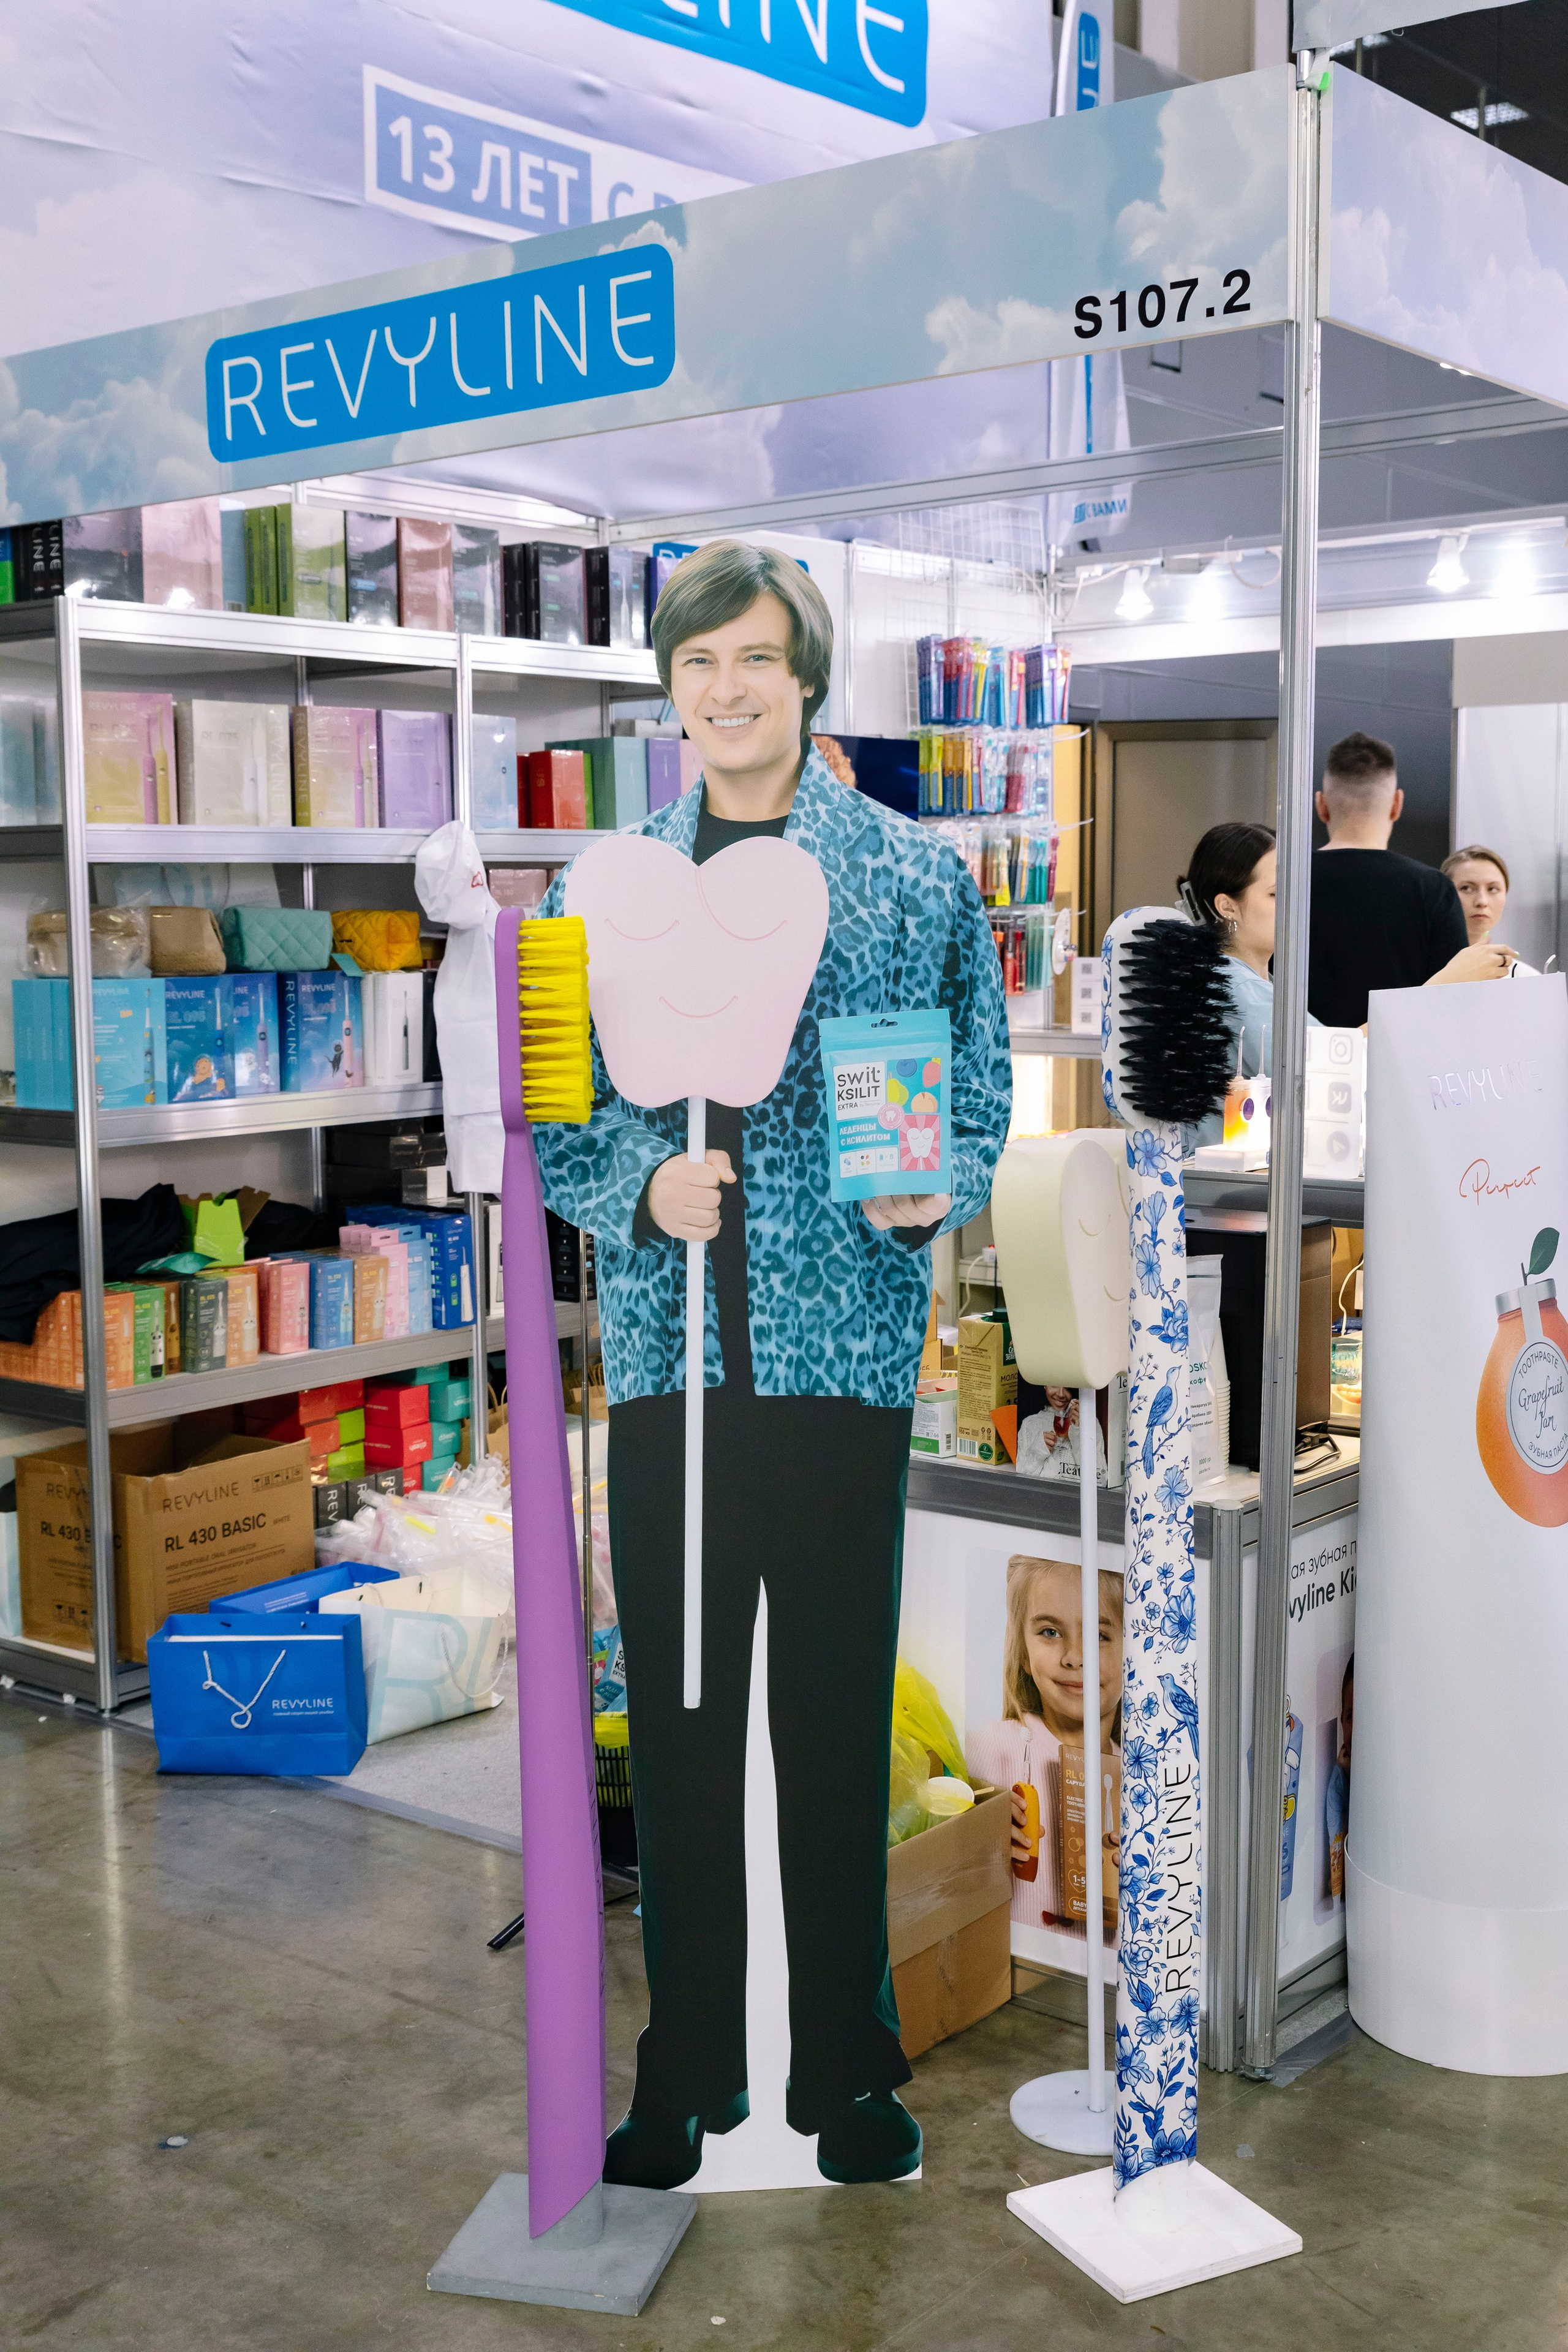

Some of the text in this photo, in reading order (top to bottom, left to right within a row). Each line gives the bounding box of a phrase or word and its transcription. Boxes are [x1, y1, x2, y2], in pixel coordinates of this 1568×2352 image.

[388, 115, 455, 192] 13
[472, 140, 579, 225] ЛЕТ
[1074, 269, 1251, 339] S107.2
[222, 270, 654, 441] REVYLINE
[165, 990, 205, 1000] REVYLINE
[301, 982, 336, 993] REVYLINE
[285, 981, 297, 1065] REVYLINE
[837, 1086, 880, 1102] KSILIT
[840, 1123, 876, 1135] ЛЕДЕНЦЫ
[846, 1133, 891, 1145] КСИЛИТОМ
[1518, 1351, 1559, 1378] TOOTHPASTE
[1189, 1377, 1207, 1385] кофе
[1518, 1375, 1564, 1421] Grapefruit
[1536, 1411, 1558, 1439] Jam
[1528, 1441, 1553, 1460] ЗУБНАЯ
[162, 1482, 239, 1513] REVYLINE
[40, 1521, 56, 1537] RL
[58, 1525, 81, 1542] 430
[165, 1534, 184, 1553] RL
[189, 1526, 217, 1545] 430
[222, 1513, 267, 1539] BASIC
[1291, 1561, 1305, 1580] ая
[1308, 1544, 1347, 1575] зубная
[1341, 1566, 1357, 1597] Ki
[272, 1697, 333, 1709] REVYLINE
[1066, 1769, 1077, 1779] RL
[1164, 1763, 1193, 1992] REVYLINE
